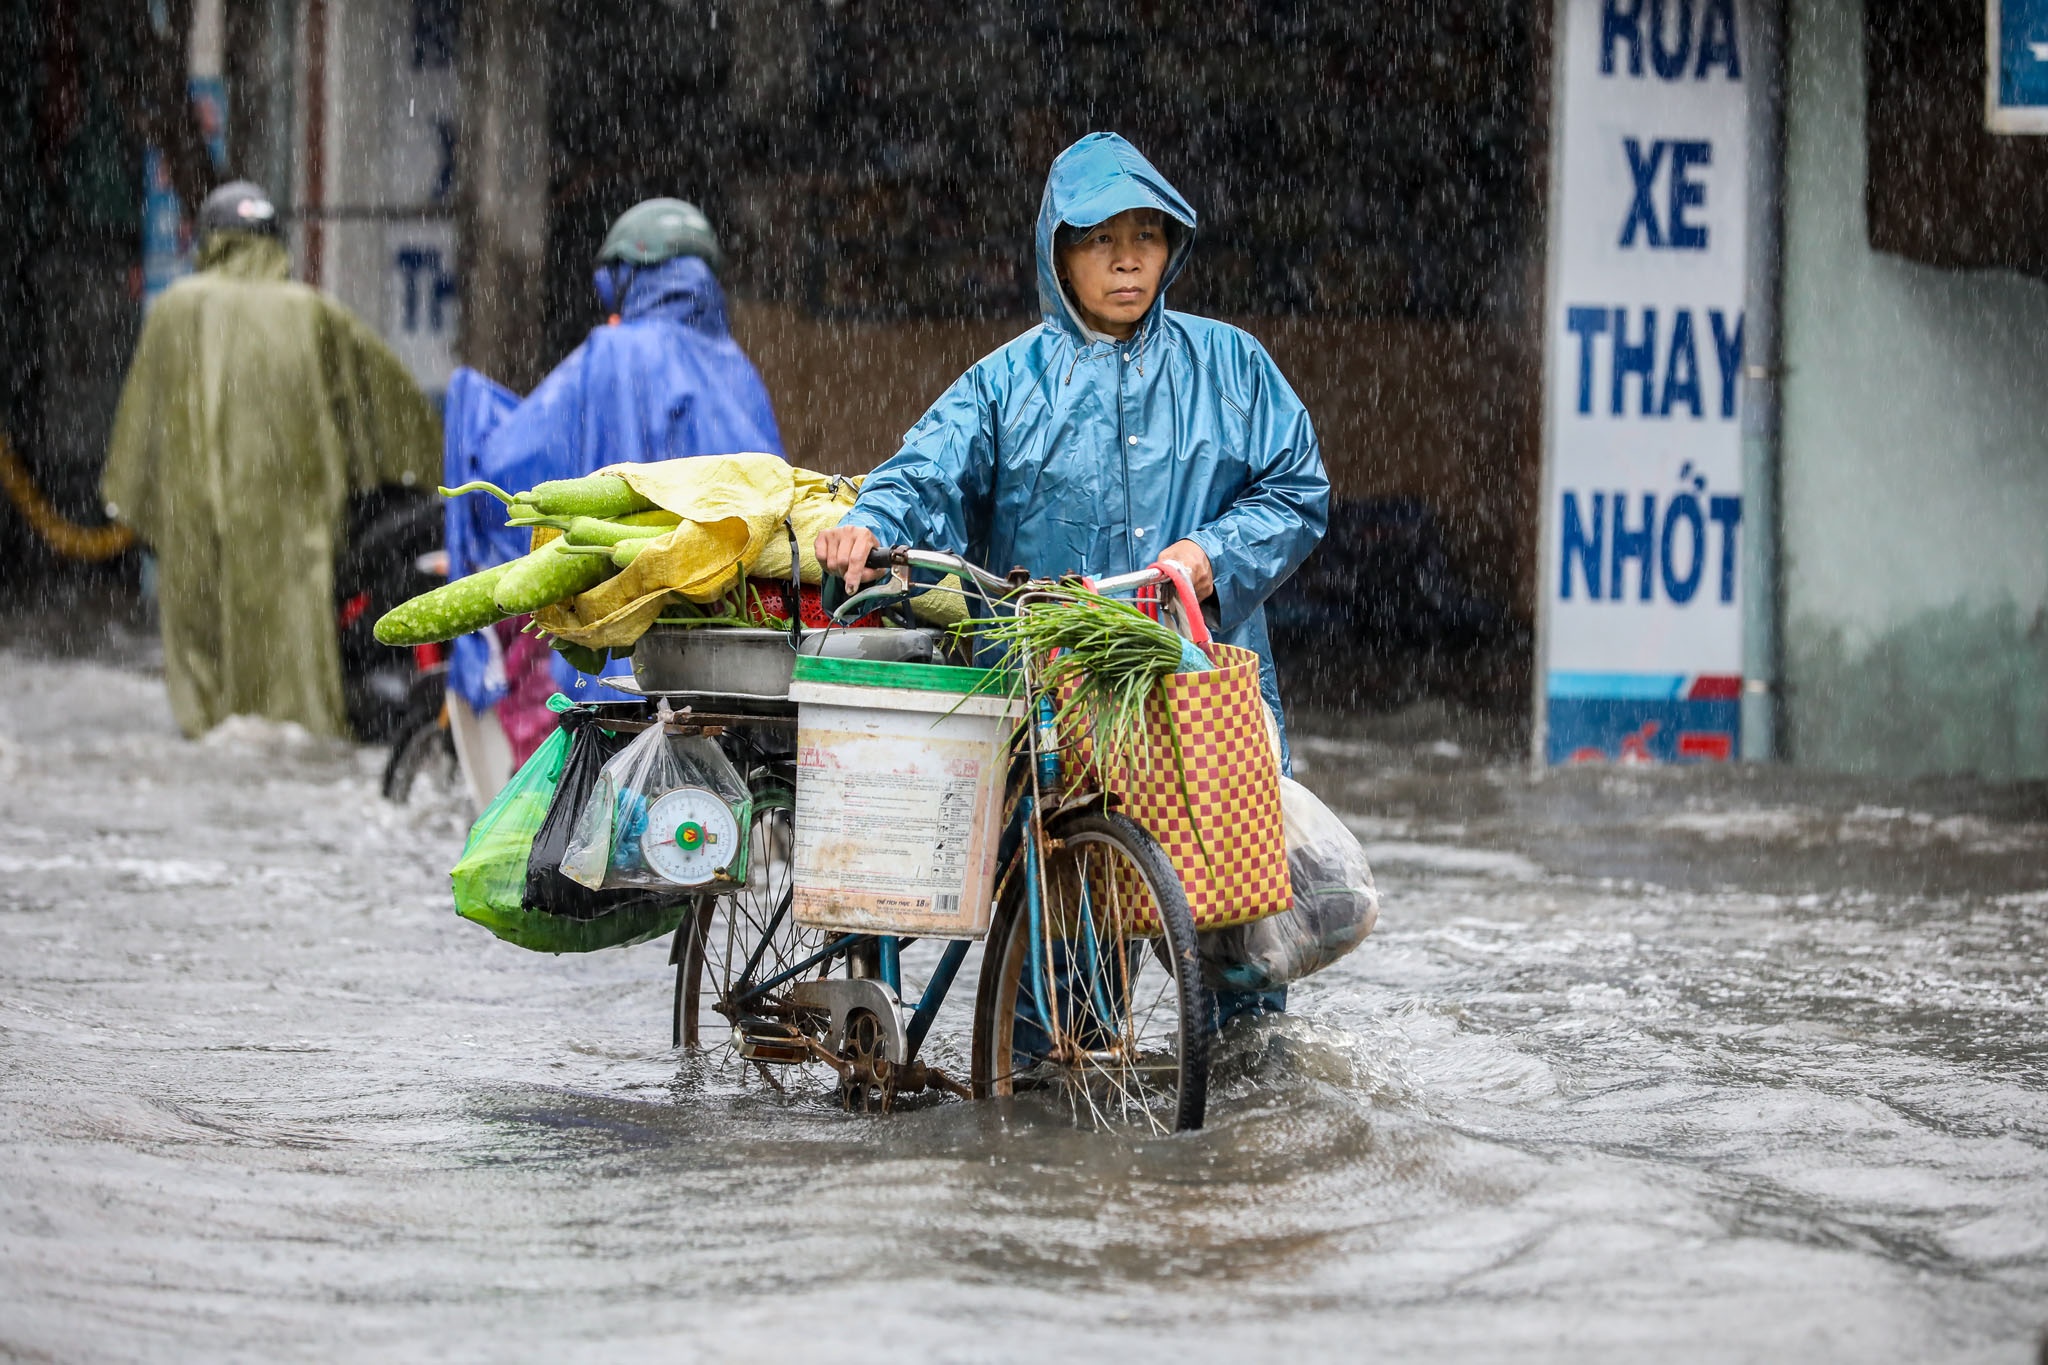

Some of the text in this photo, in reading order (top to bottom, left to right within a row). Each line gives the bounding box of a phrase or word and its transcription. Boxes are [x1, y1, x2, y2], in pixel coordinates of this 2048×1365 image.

[1619, 137, 1711, 249] XE
[1567, 306, 1745, 419] THAY
[1560, 461, 1742, 607] NHỚT
[916, 899, 925, 907] 18
